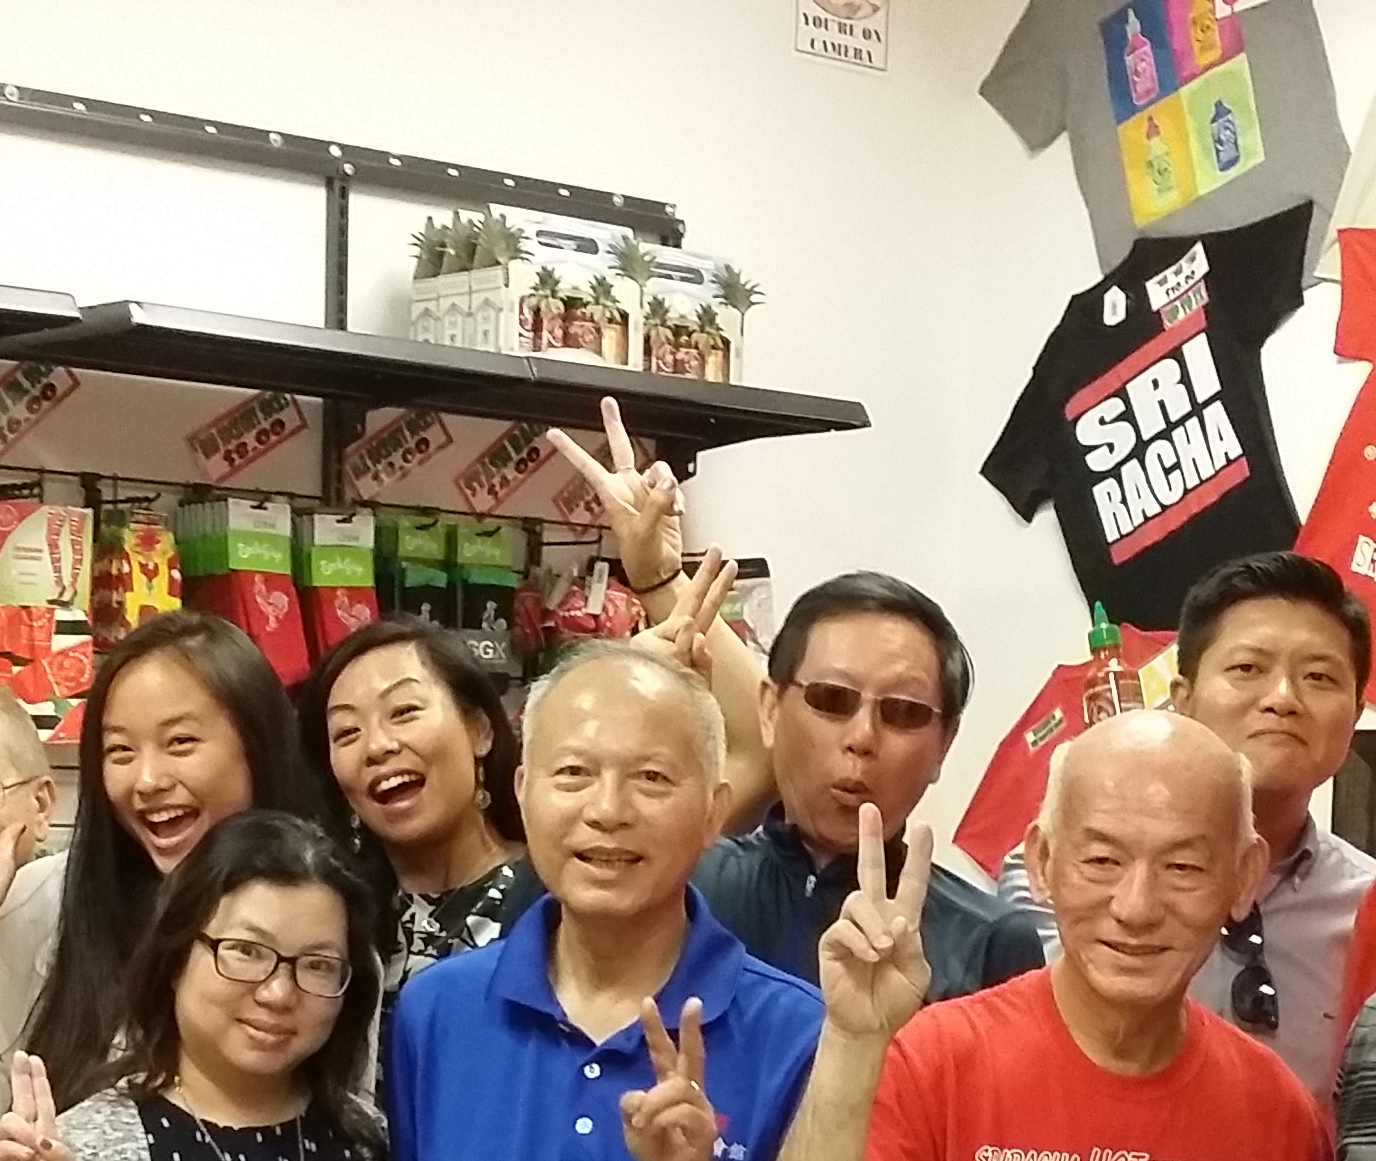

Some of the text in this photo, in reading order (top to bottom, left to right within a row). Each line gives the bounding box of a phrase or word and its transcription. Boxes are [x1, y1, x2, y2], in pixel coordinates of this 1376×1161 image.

[810, 37, 874, 64] CAMERA
[1075, 332, 1223, 472] SRI
[1092, 400, 1244, 543] RACHA
